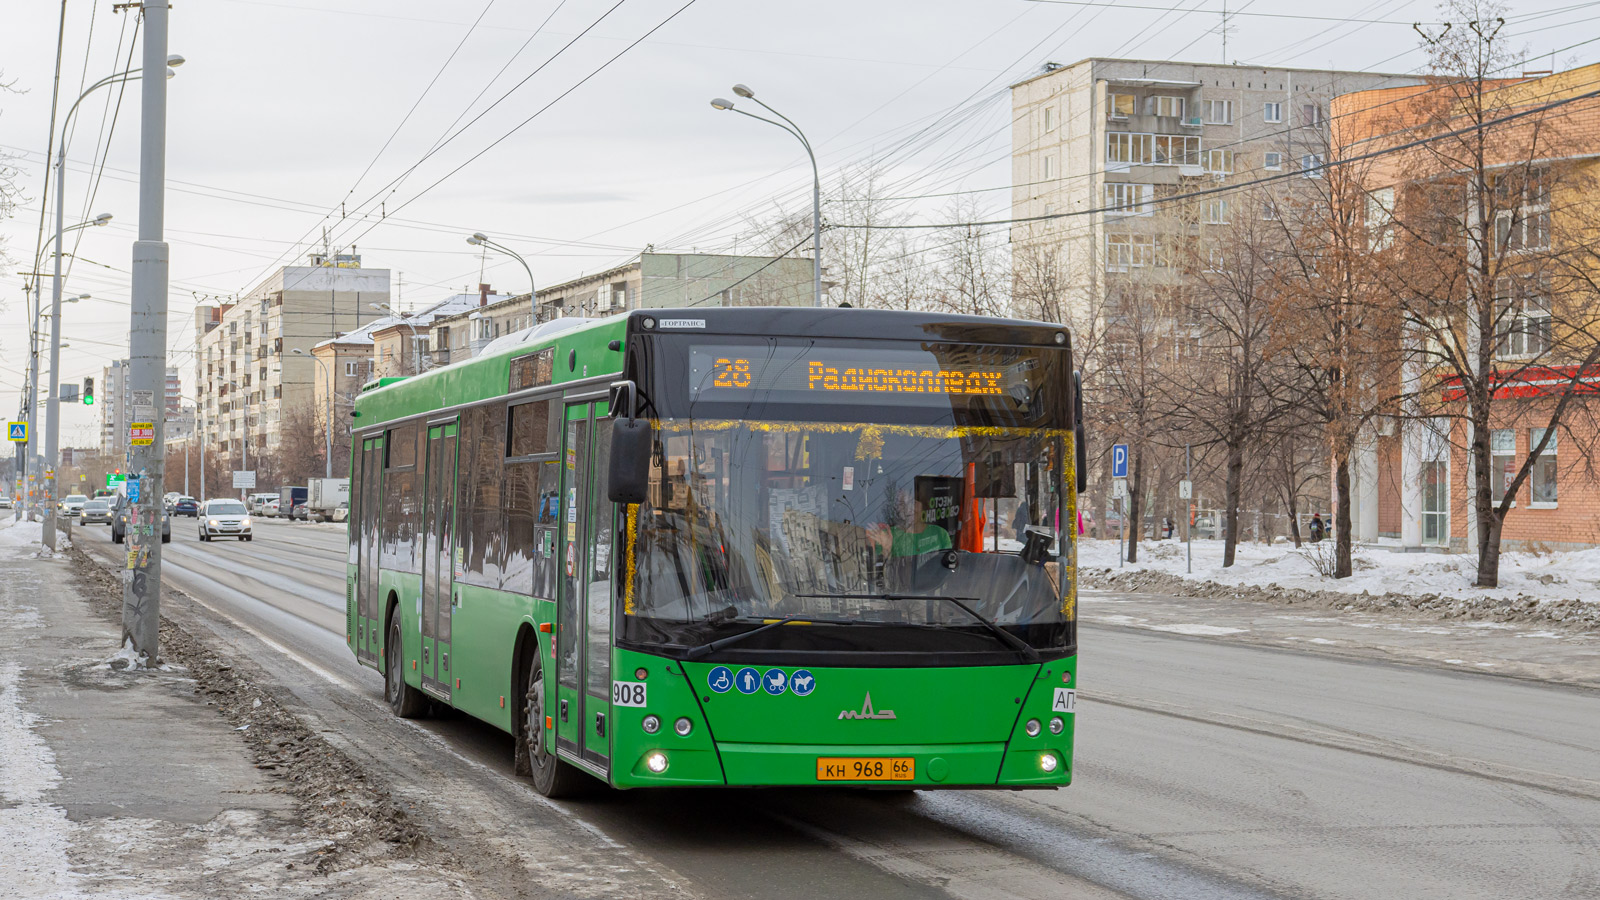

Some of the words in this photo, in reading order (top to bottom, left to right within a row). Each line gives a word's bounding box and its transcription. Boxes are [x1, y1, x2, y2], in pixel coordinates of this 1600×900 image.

[714, 358, 751, 388] 28
[808, 361, 1003, 394] Радиоколледж
[613, 683, 645, 704] 908
[826, 765, 845, 777] КН
[854, 762, 883, 777] 968
[893, 761, 908, 772] 66
